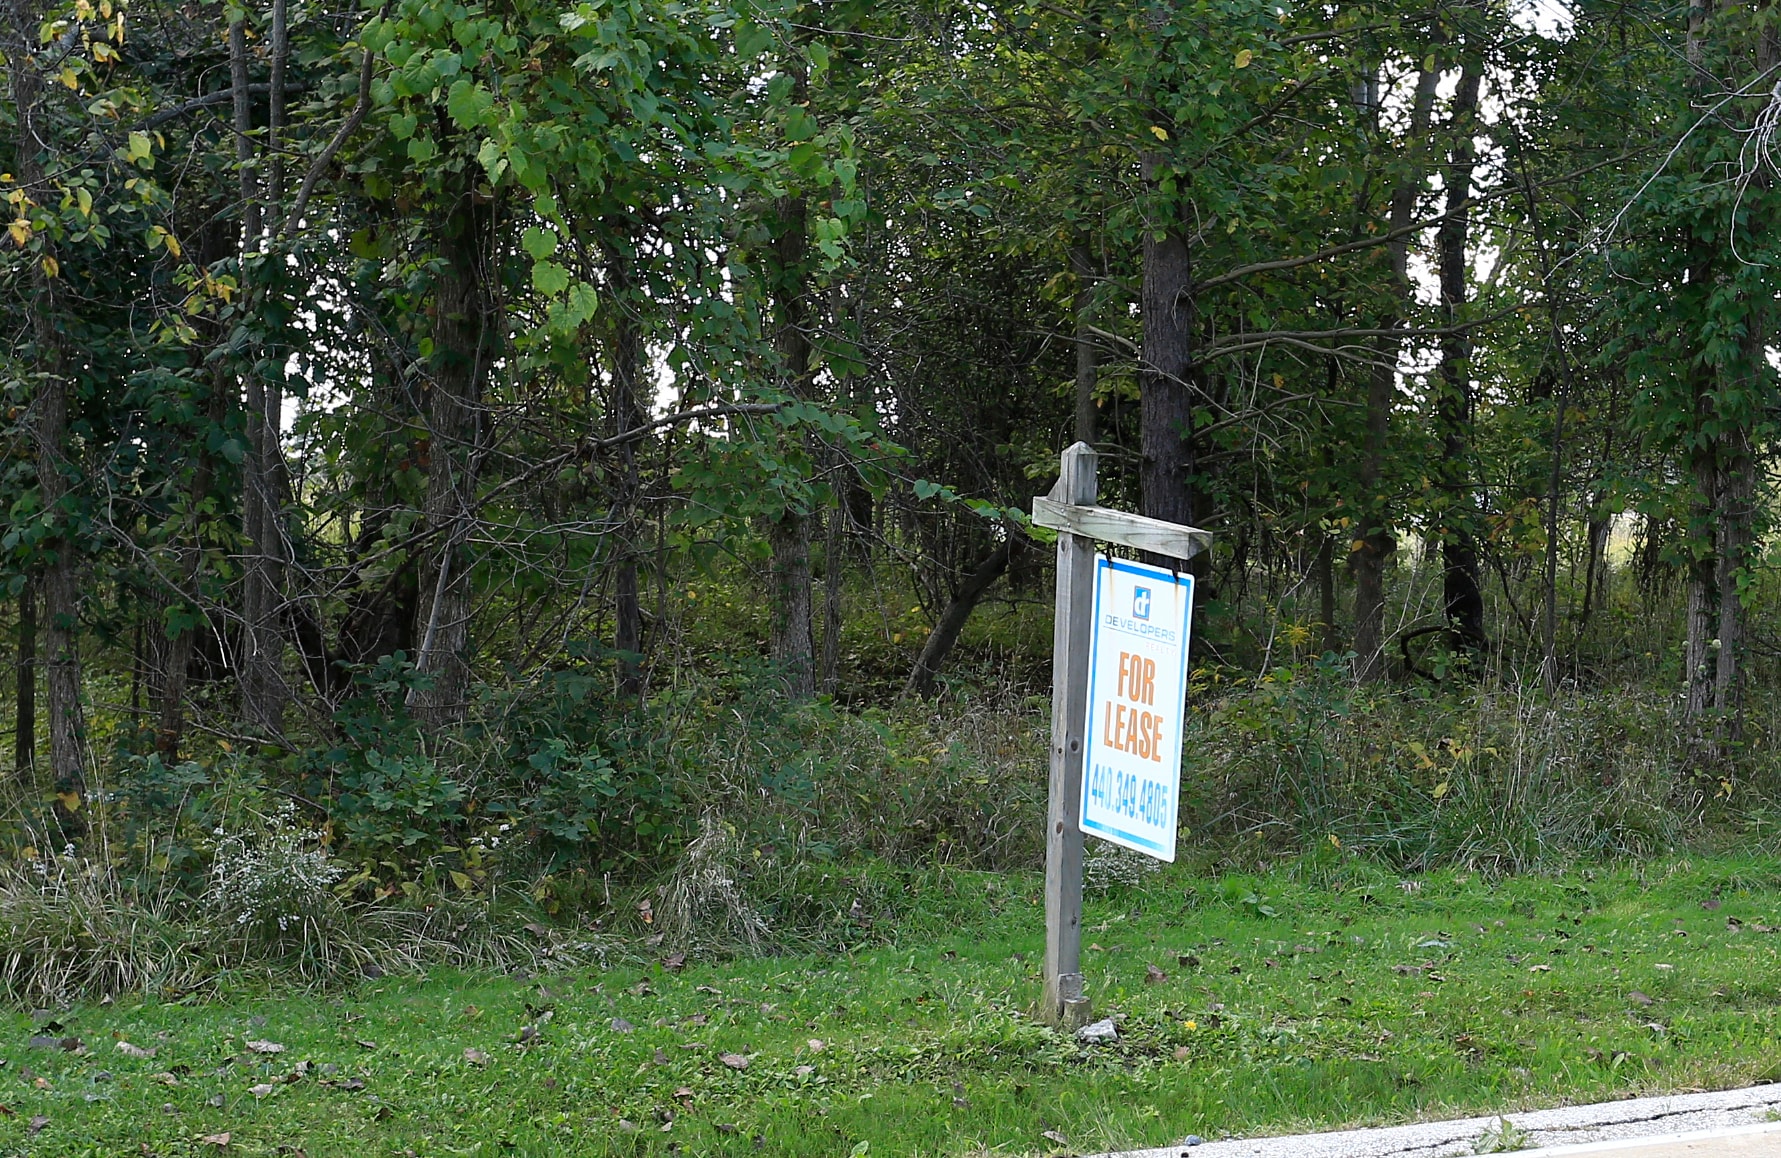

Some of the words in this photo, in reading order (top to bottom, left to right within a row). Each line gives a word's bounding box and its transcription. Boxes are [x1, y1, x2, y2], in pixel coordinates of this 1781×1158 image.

[1105, 614, 1175, 641] DEVELOPERS
[1118, 651, 1155, 706] FOR
[1104, 700, 1163, 762] LEASE
[1092, 763, 1168, 829] 440.349.4805
